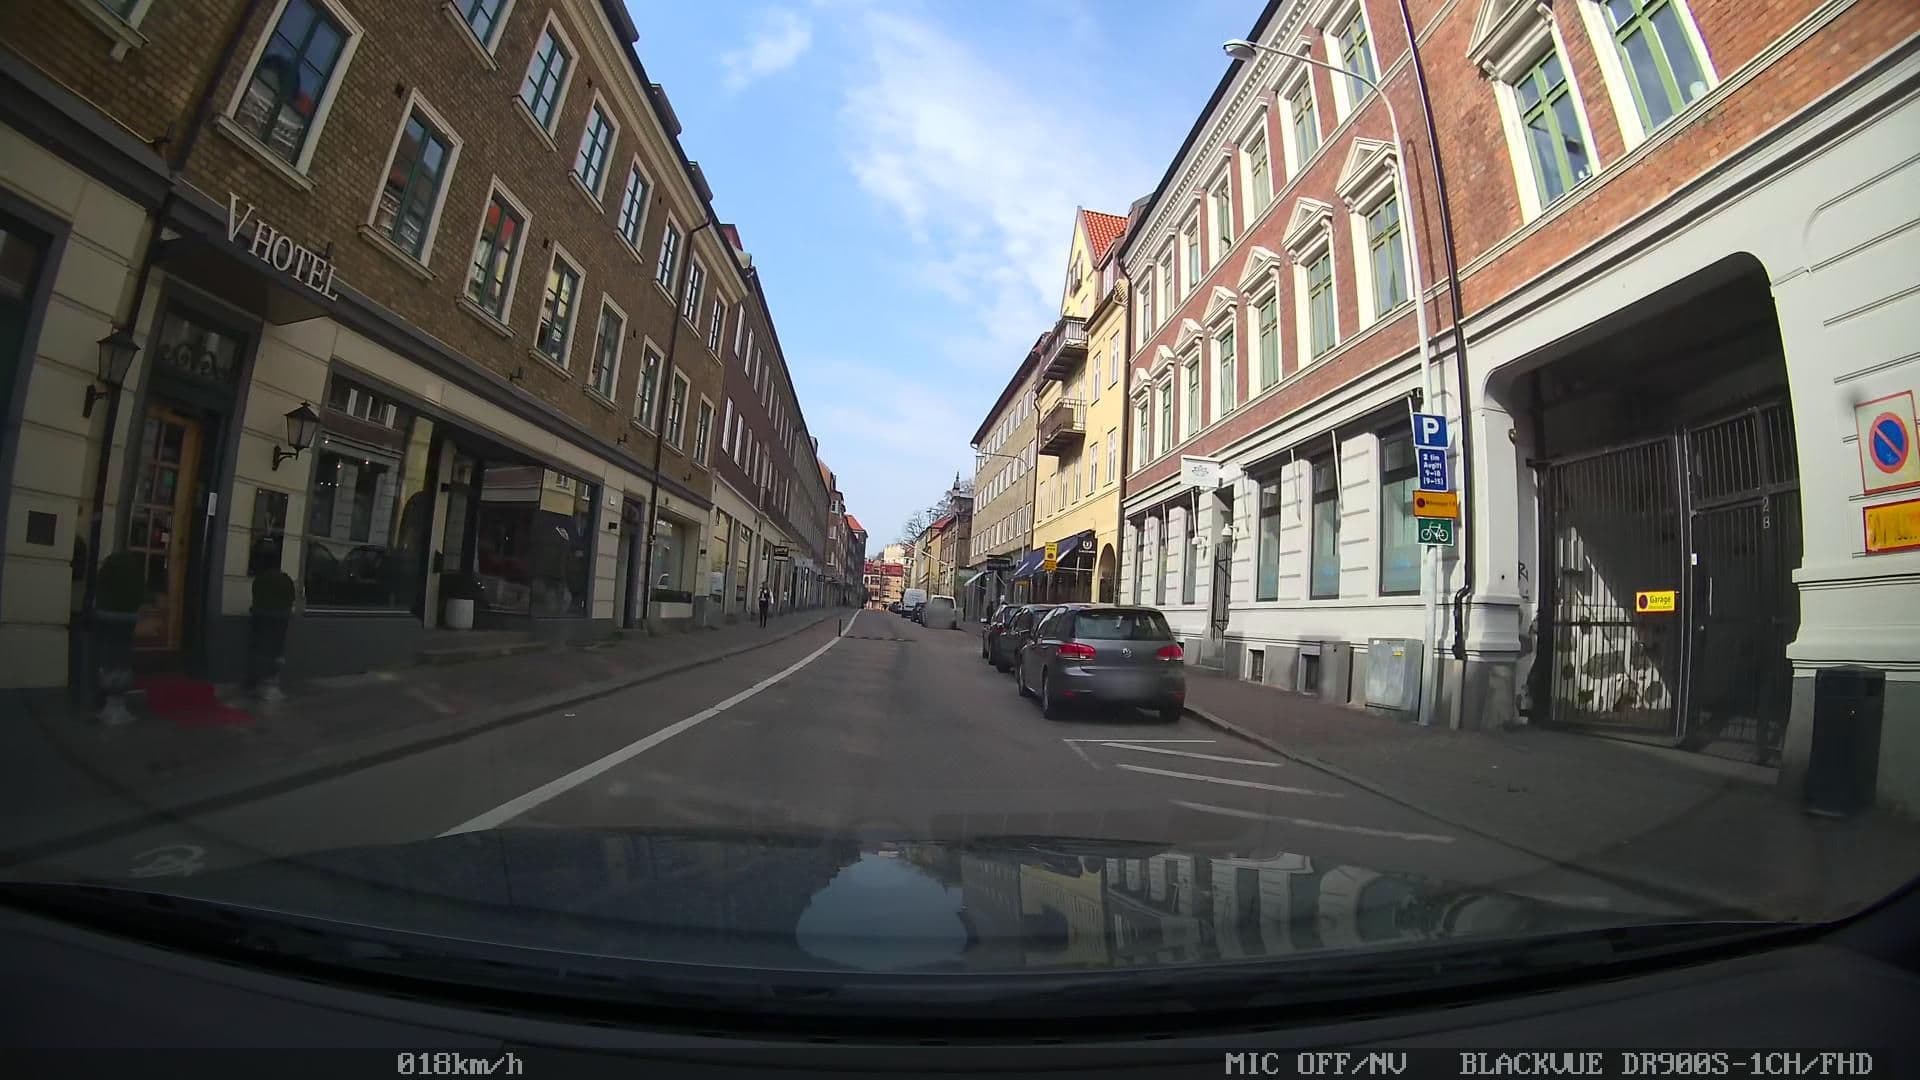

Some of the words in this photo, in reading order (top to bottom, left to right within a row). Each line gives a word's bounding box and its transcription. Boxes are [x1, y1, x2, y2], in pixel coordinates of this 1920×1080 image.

[228, 192, 255, 243] V
[248, 219, 338, 302] HOTEL
[1422, 417, 1439, 444] P
[1650, 596, 1671, 605] Garage
